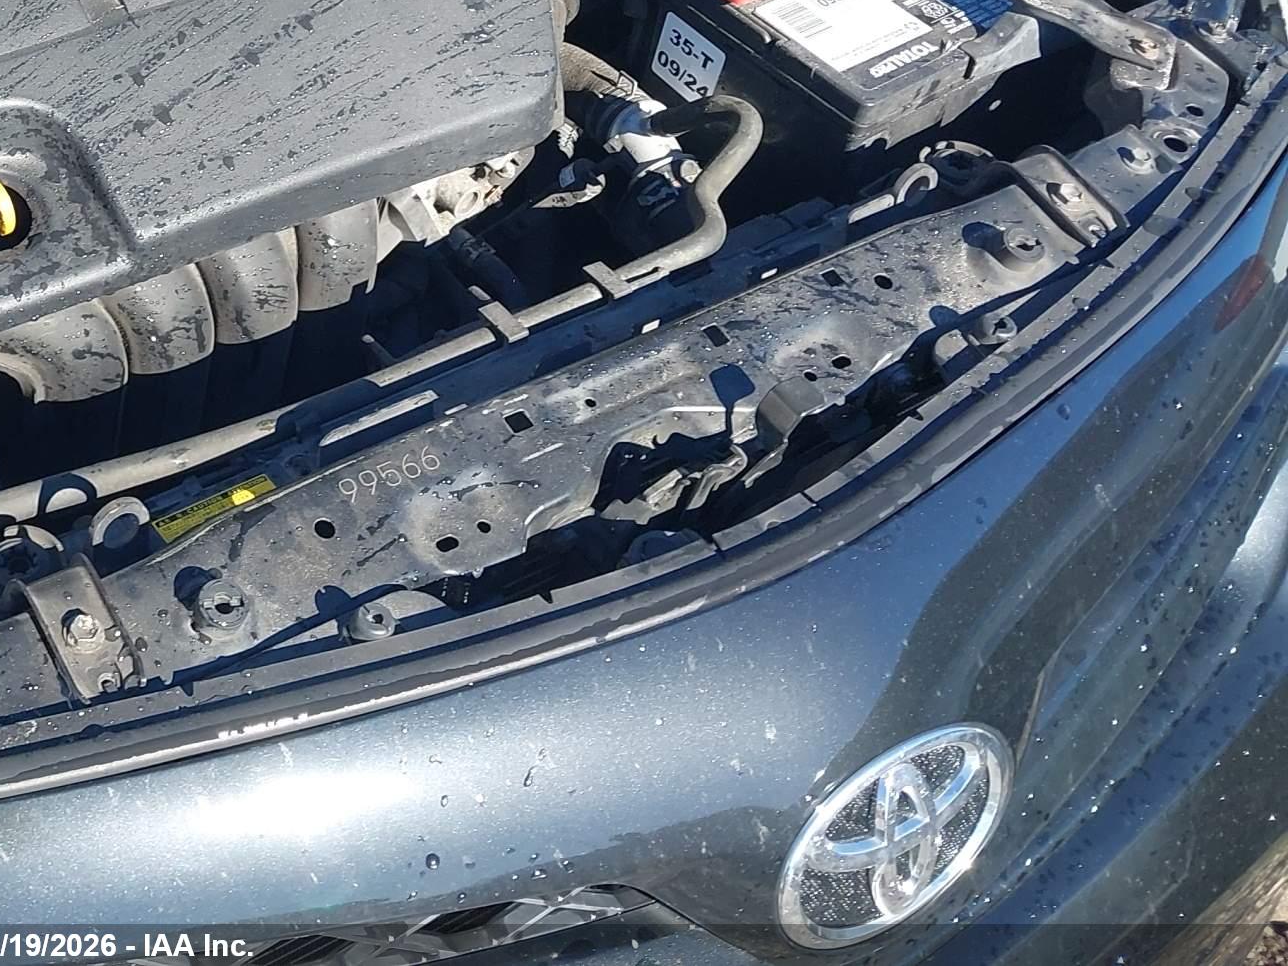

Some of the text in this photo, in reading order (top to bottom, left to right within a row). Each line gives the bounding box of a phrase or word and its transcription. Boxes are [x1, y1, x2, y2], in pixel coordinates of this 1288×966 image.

[669, 28, 714, 69] 35-T
[657, 50, 710, 98] 09/24
[338, 445, 441, 503] 99566
